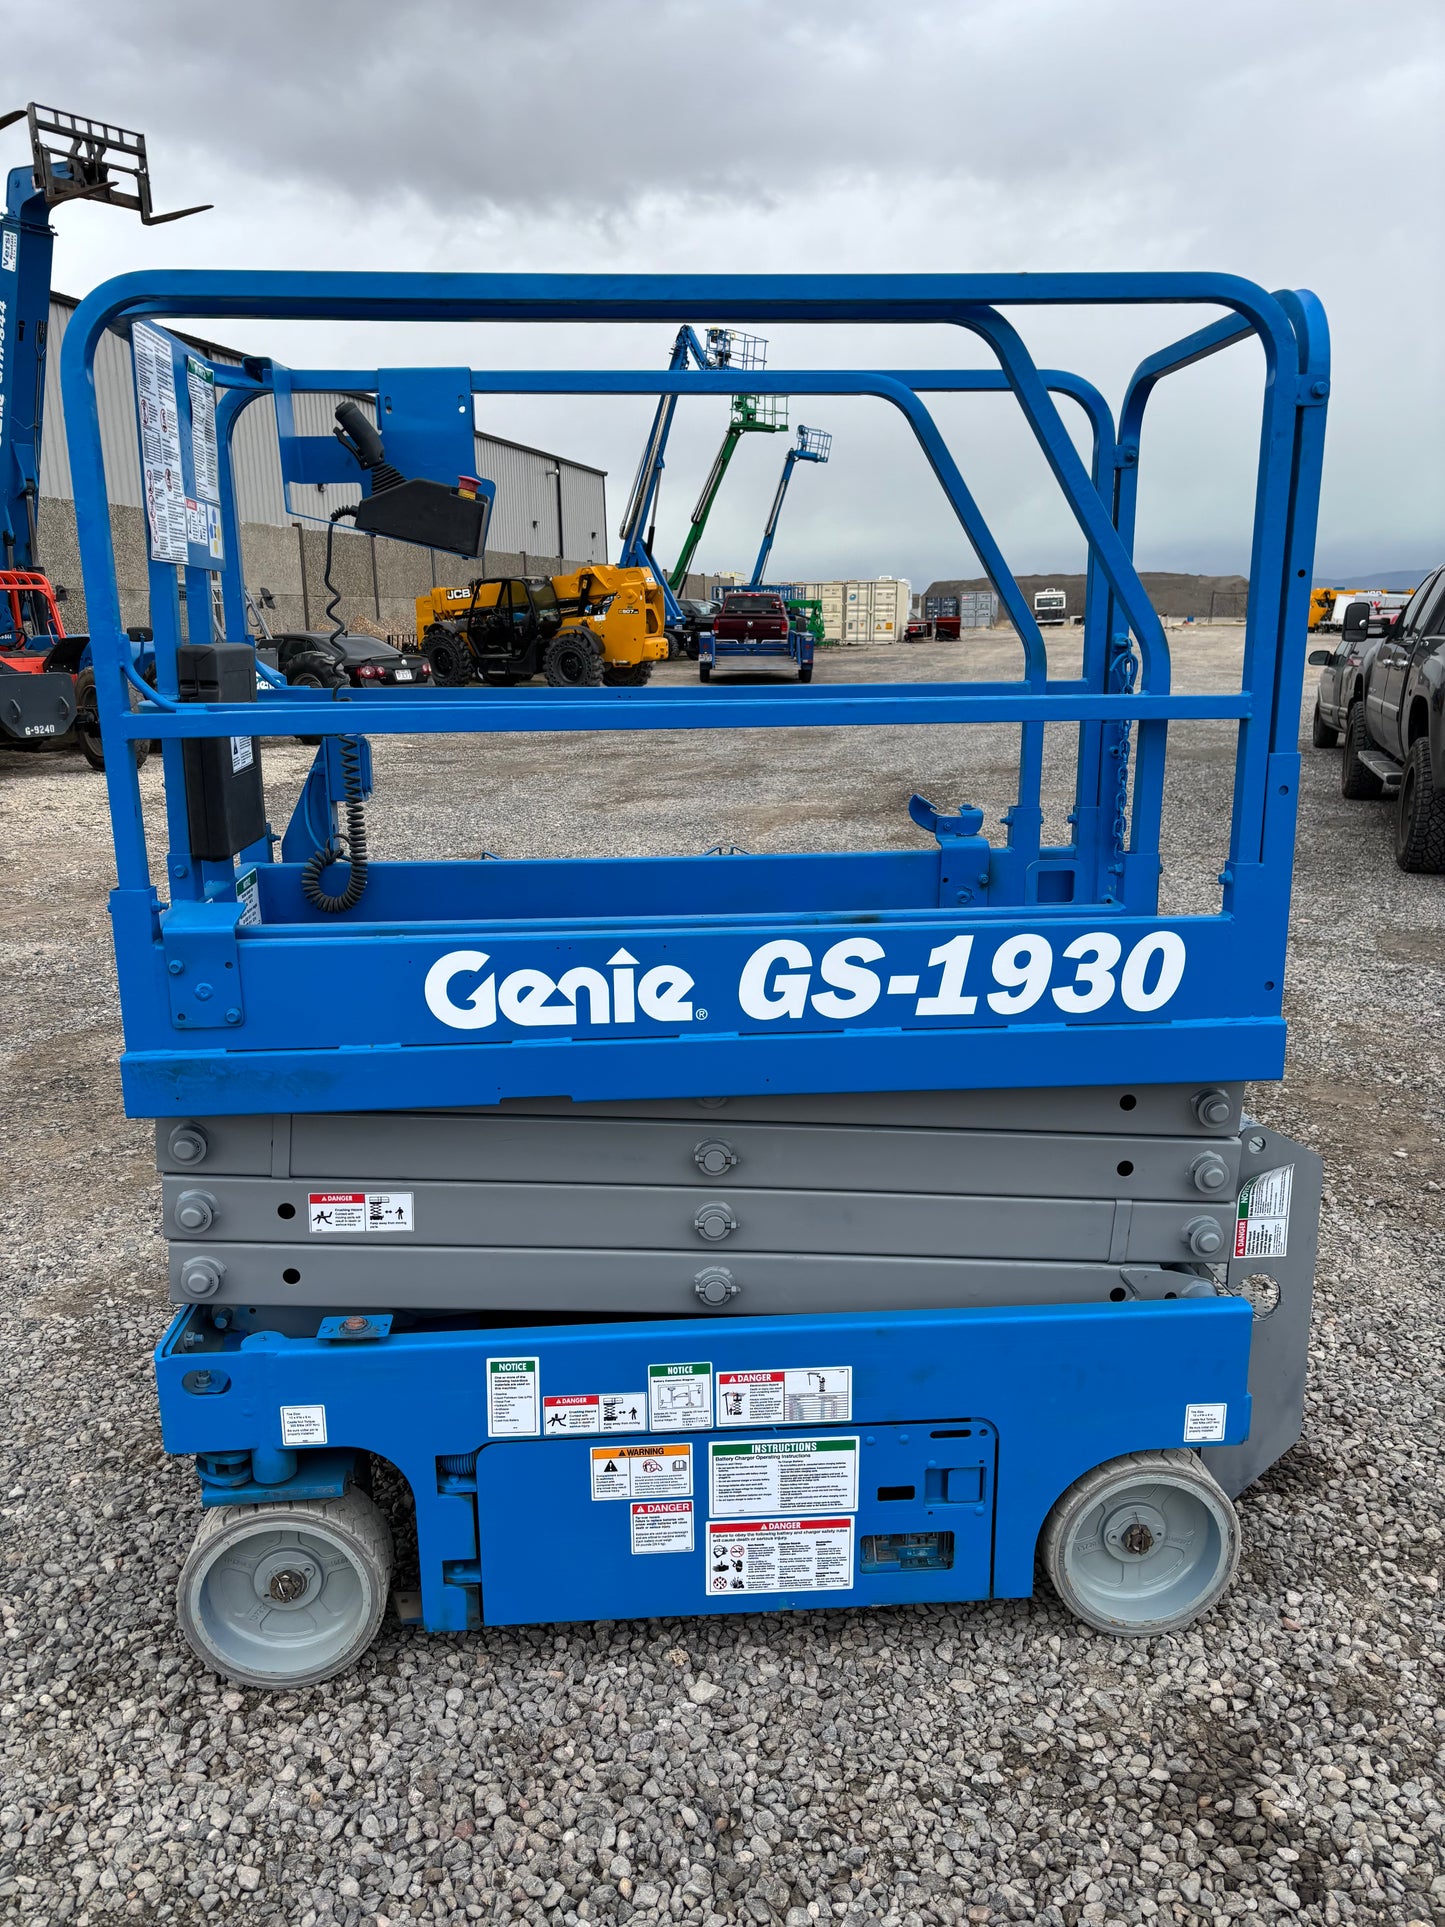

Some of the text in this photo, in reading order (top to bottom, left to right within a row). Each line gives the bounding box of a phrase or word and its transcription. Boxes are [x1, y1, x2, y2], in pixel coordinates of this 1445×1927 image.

[447, 588, 470, 600] JCB
[24, 724, 55, 736] G-9240
[424, 930, 1186, 1030] Genie GS-1930
[1238, 1221, 1246, 1247] DANGER
[498, 1362, 527, 1371] NOTICE
[668, 1366, 693, 1374] NOTICE
[737, 1374, 772, 1382] DANGER
[627, 1448, 664, 1456] WARNING
[752, 1442, 817, 1454] INSTRUCTIONS
[647, 1502, 690, 1512] DANGER
[768, 1522, 801, 1530] DANGER
